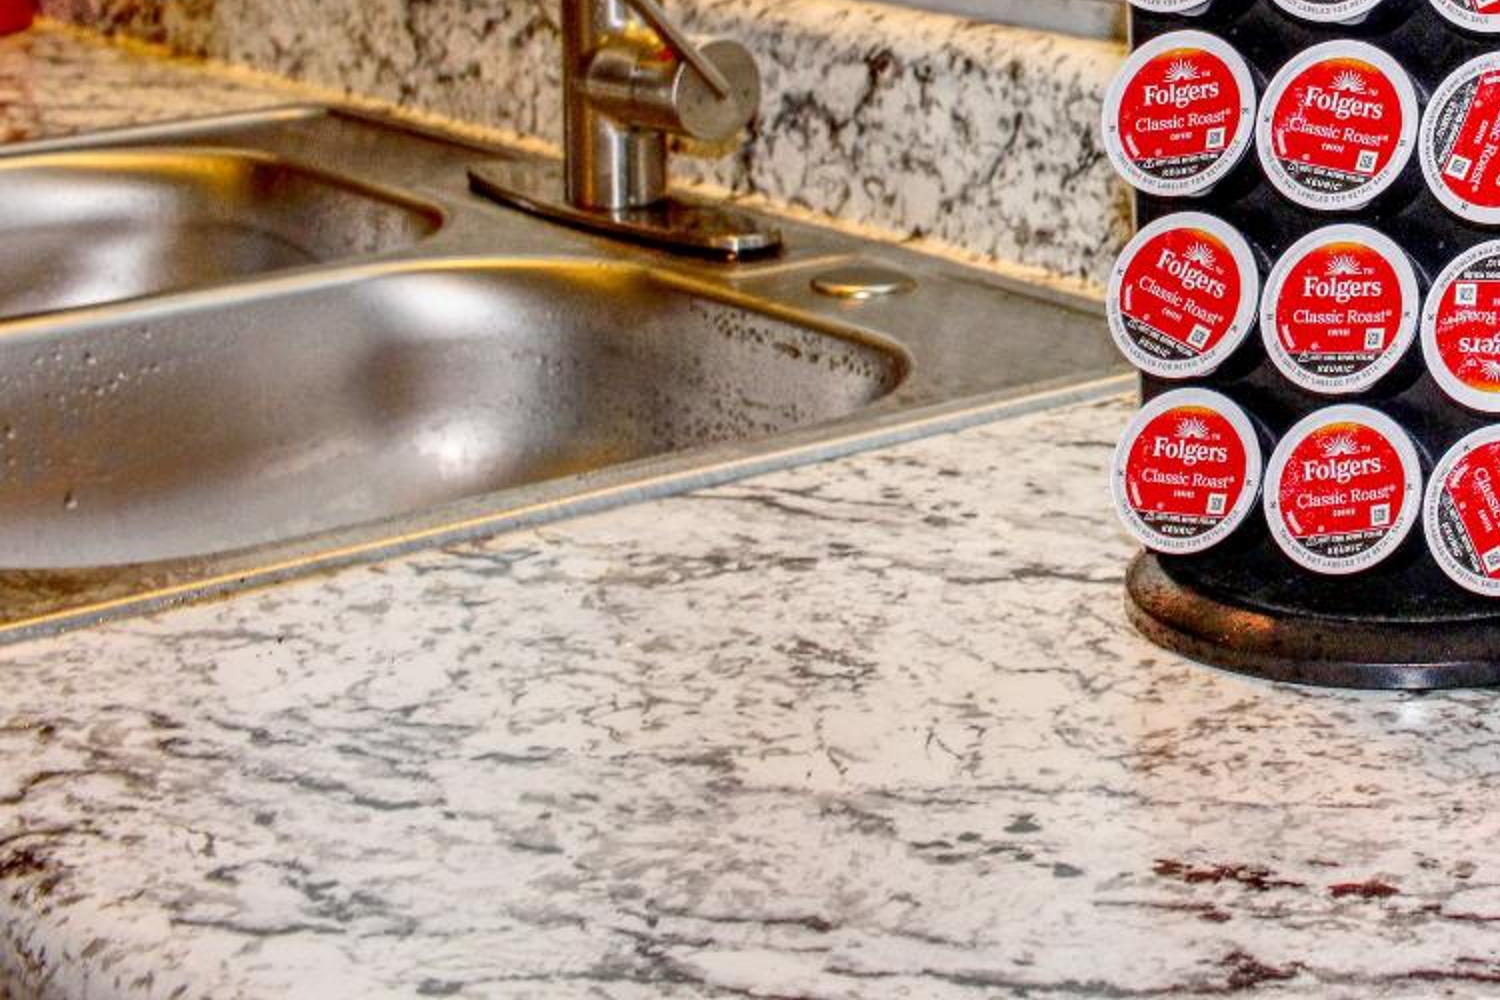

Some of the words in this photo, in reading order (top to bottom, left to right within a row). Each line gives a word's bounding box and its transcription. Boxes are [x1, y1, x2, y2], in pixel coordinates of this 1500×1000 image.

[1143, 80, 1219, 108] Folgers
[1304, 85, 1383, 120] Folgers
[1135, 113, 1185, 132] Classic
[1288, 116, 1340, 140] Classic
[1155, 248, 1226, 299] Folgers
[1139, 275, 1183, 307] Classic
[1303, 276, 1382, 303] Folgers
[1293, 309, 1344, 324] Classic
[1152, 435, 1227, 466] Folgers
[1141, 467, 1189, 486] Classic
[1303, 457, 1381, 484] Folgers
[1296, 493, 1347, 509] Classic
